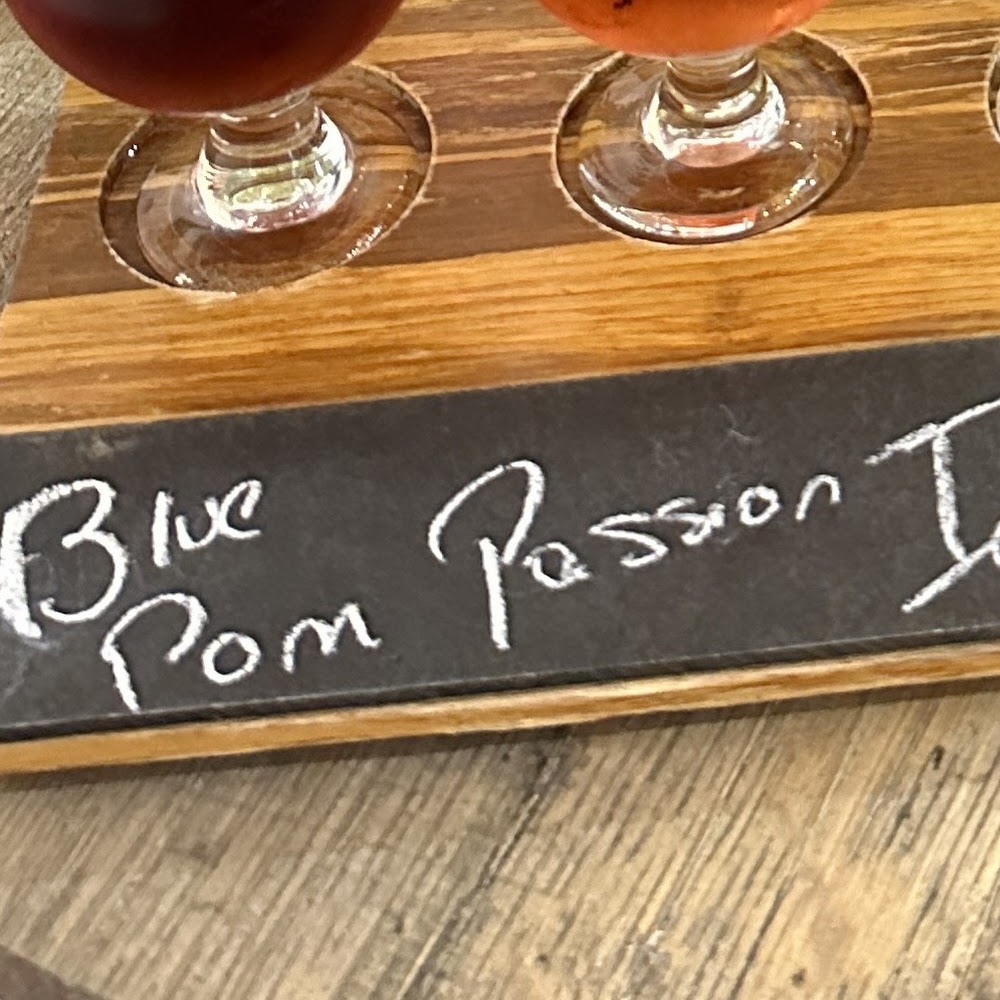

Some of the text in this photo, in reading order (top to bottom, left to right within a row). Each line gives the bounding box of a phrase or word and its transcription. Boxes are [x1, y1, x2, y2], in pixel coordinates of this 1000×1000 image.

[0, 478, 264, 640] Blue
[428, 458, 842, 651] Passion
[100, 592, 382, 712] Pom
